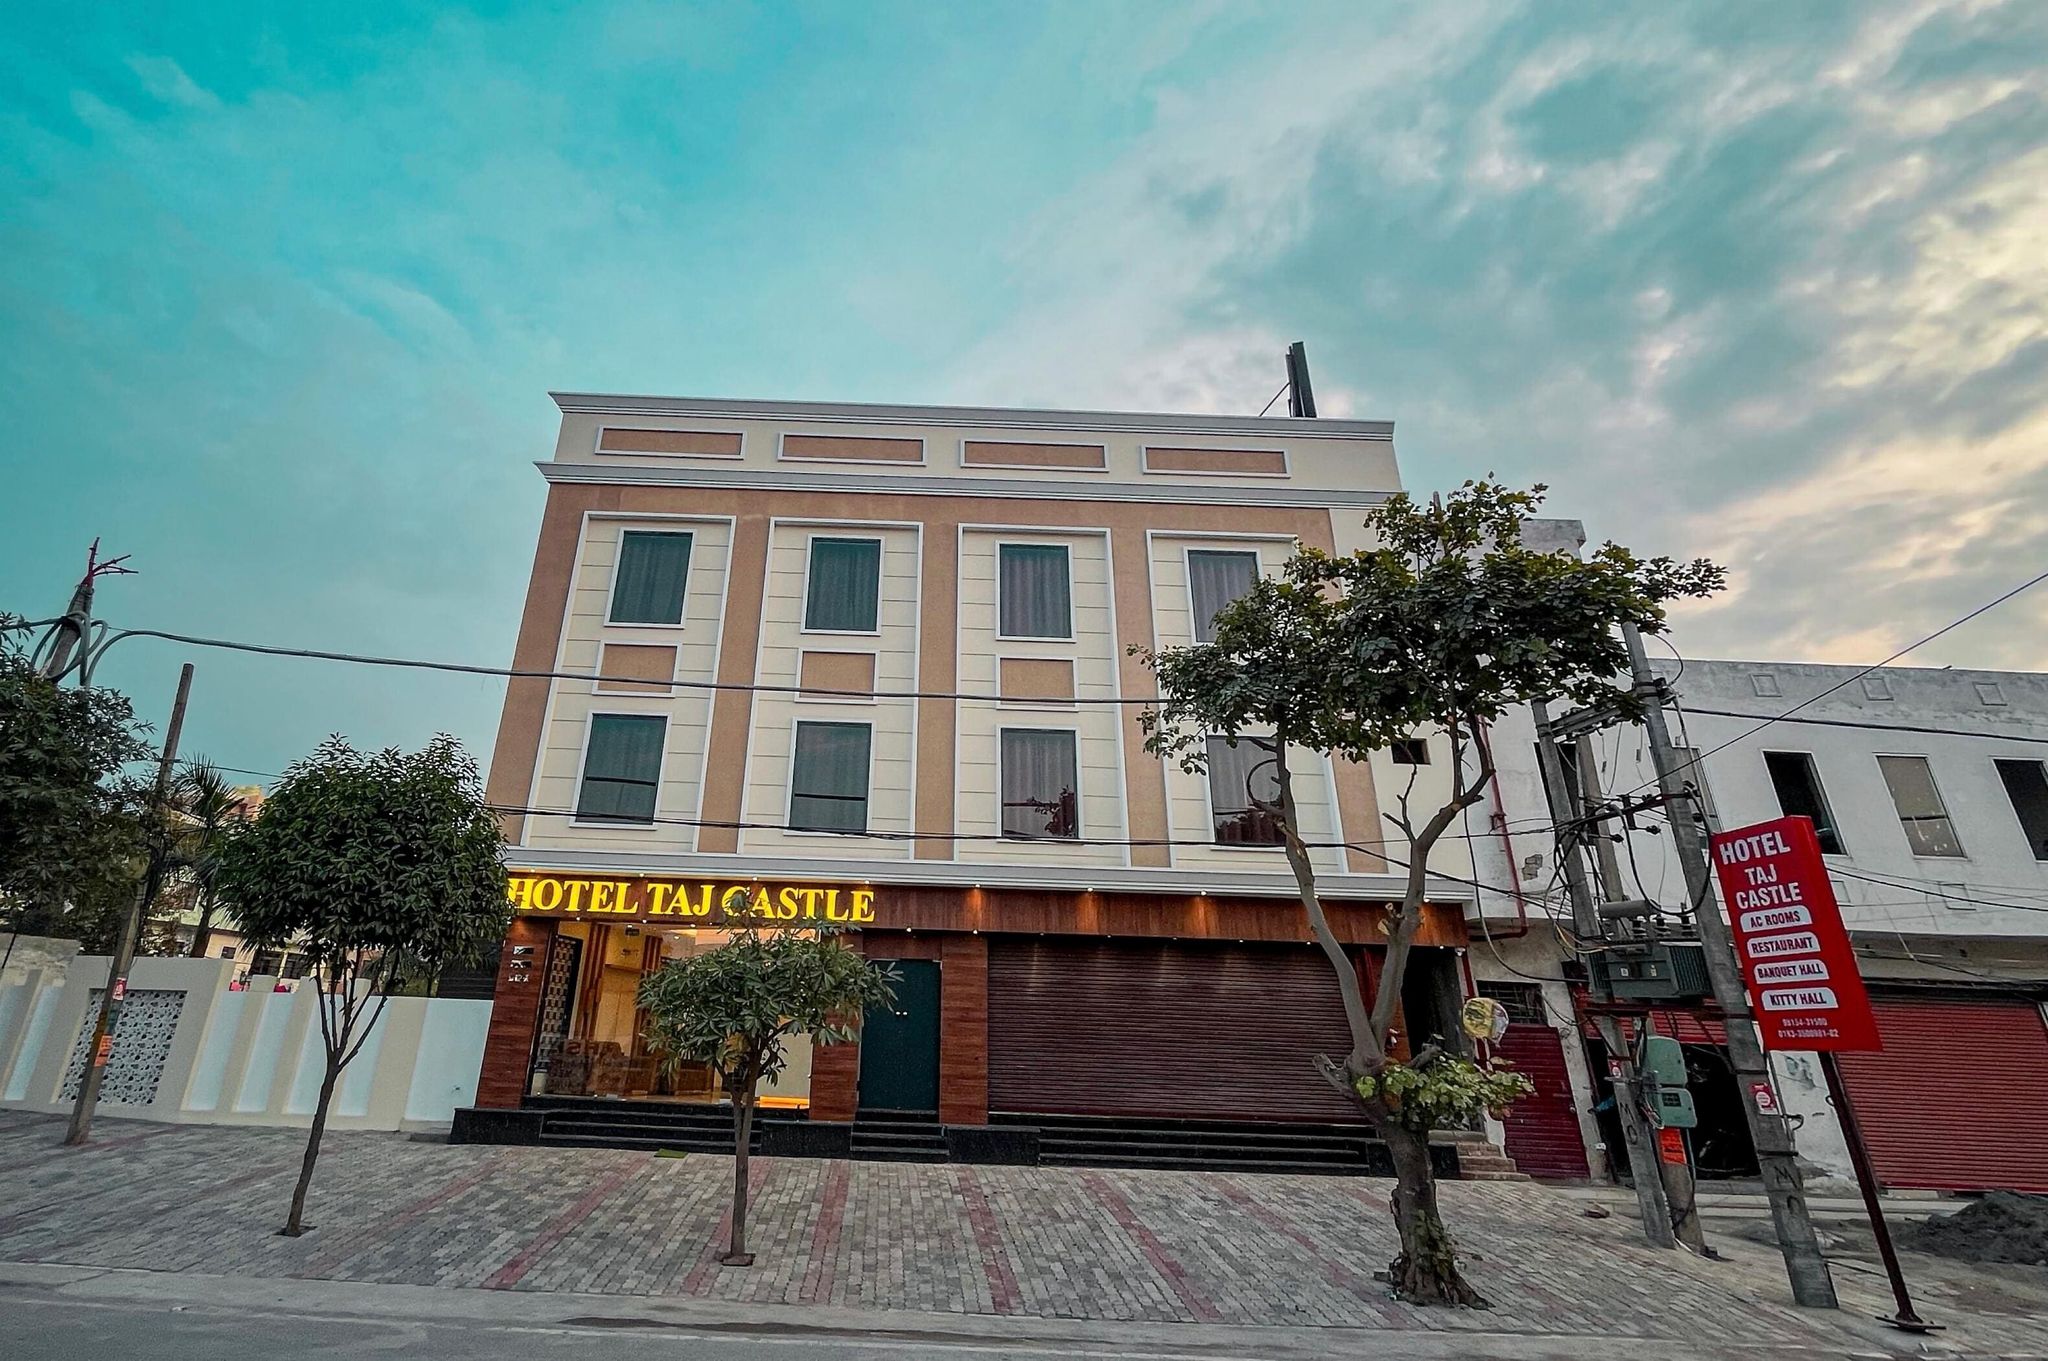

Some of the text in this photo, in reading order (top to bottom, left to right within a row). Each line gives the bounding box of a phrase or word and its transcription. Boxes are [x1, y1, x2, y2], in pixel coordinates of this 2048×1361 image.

[1719, 831, 1791, 865] HOTEL
[1744, 864, 1778, 885] TAJ
[507, 878, 875, 922] HOTEL TAJ CASTLE
[1735, 882, 1802, 909] CASTLE
[1750, 911, 1801, 928] AC ROOMS
[1751, 937, 1813, 954] RESTAURANT
[1757, 963, 1824, 979] BANQUET HALL
[1769, 991, 1827, 1006] KITTY HALL
